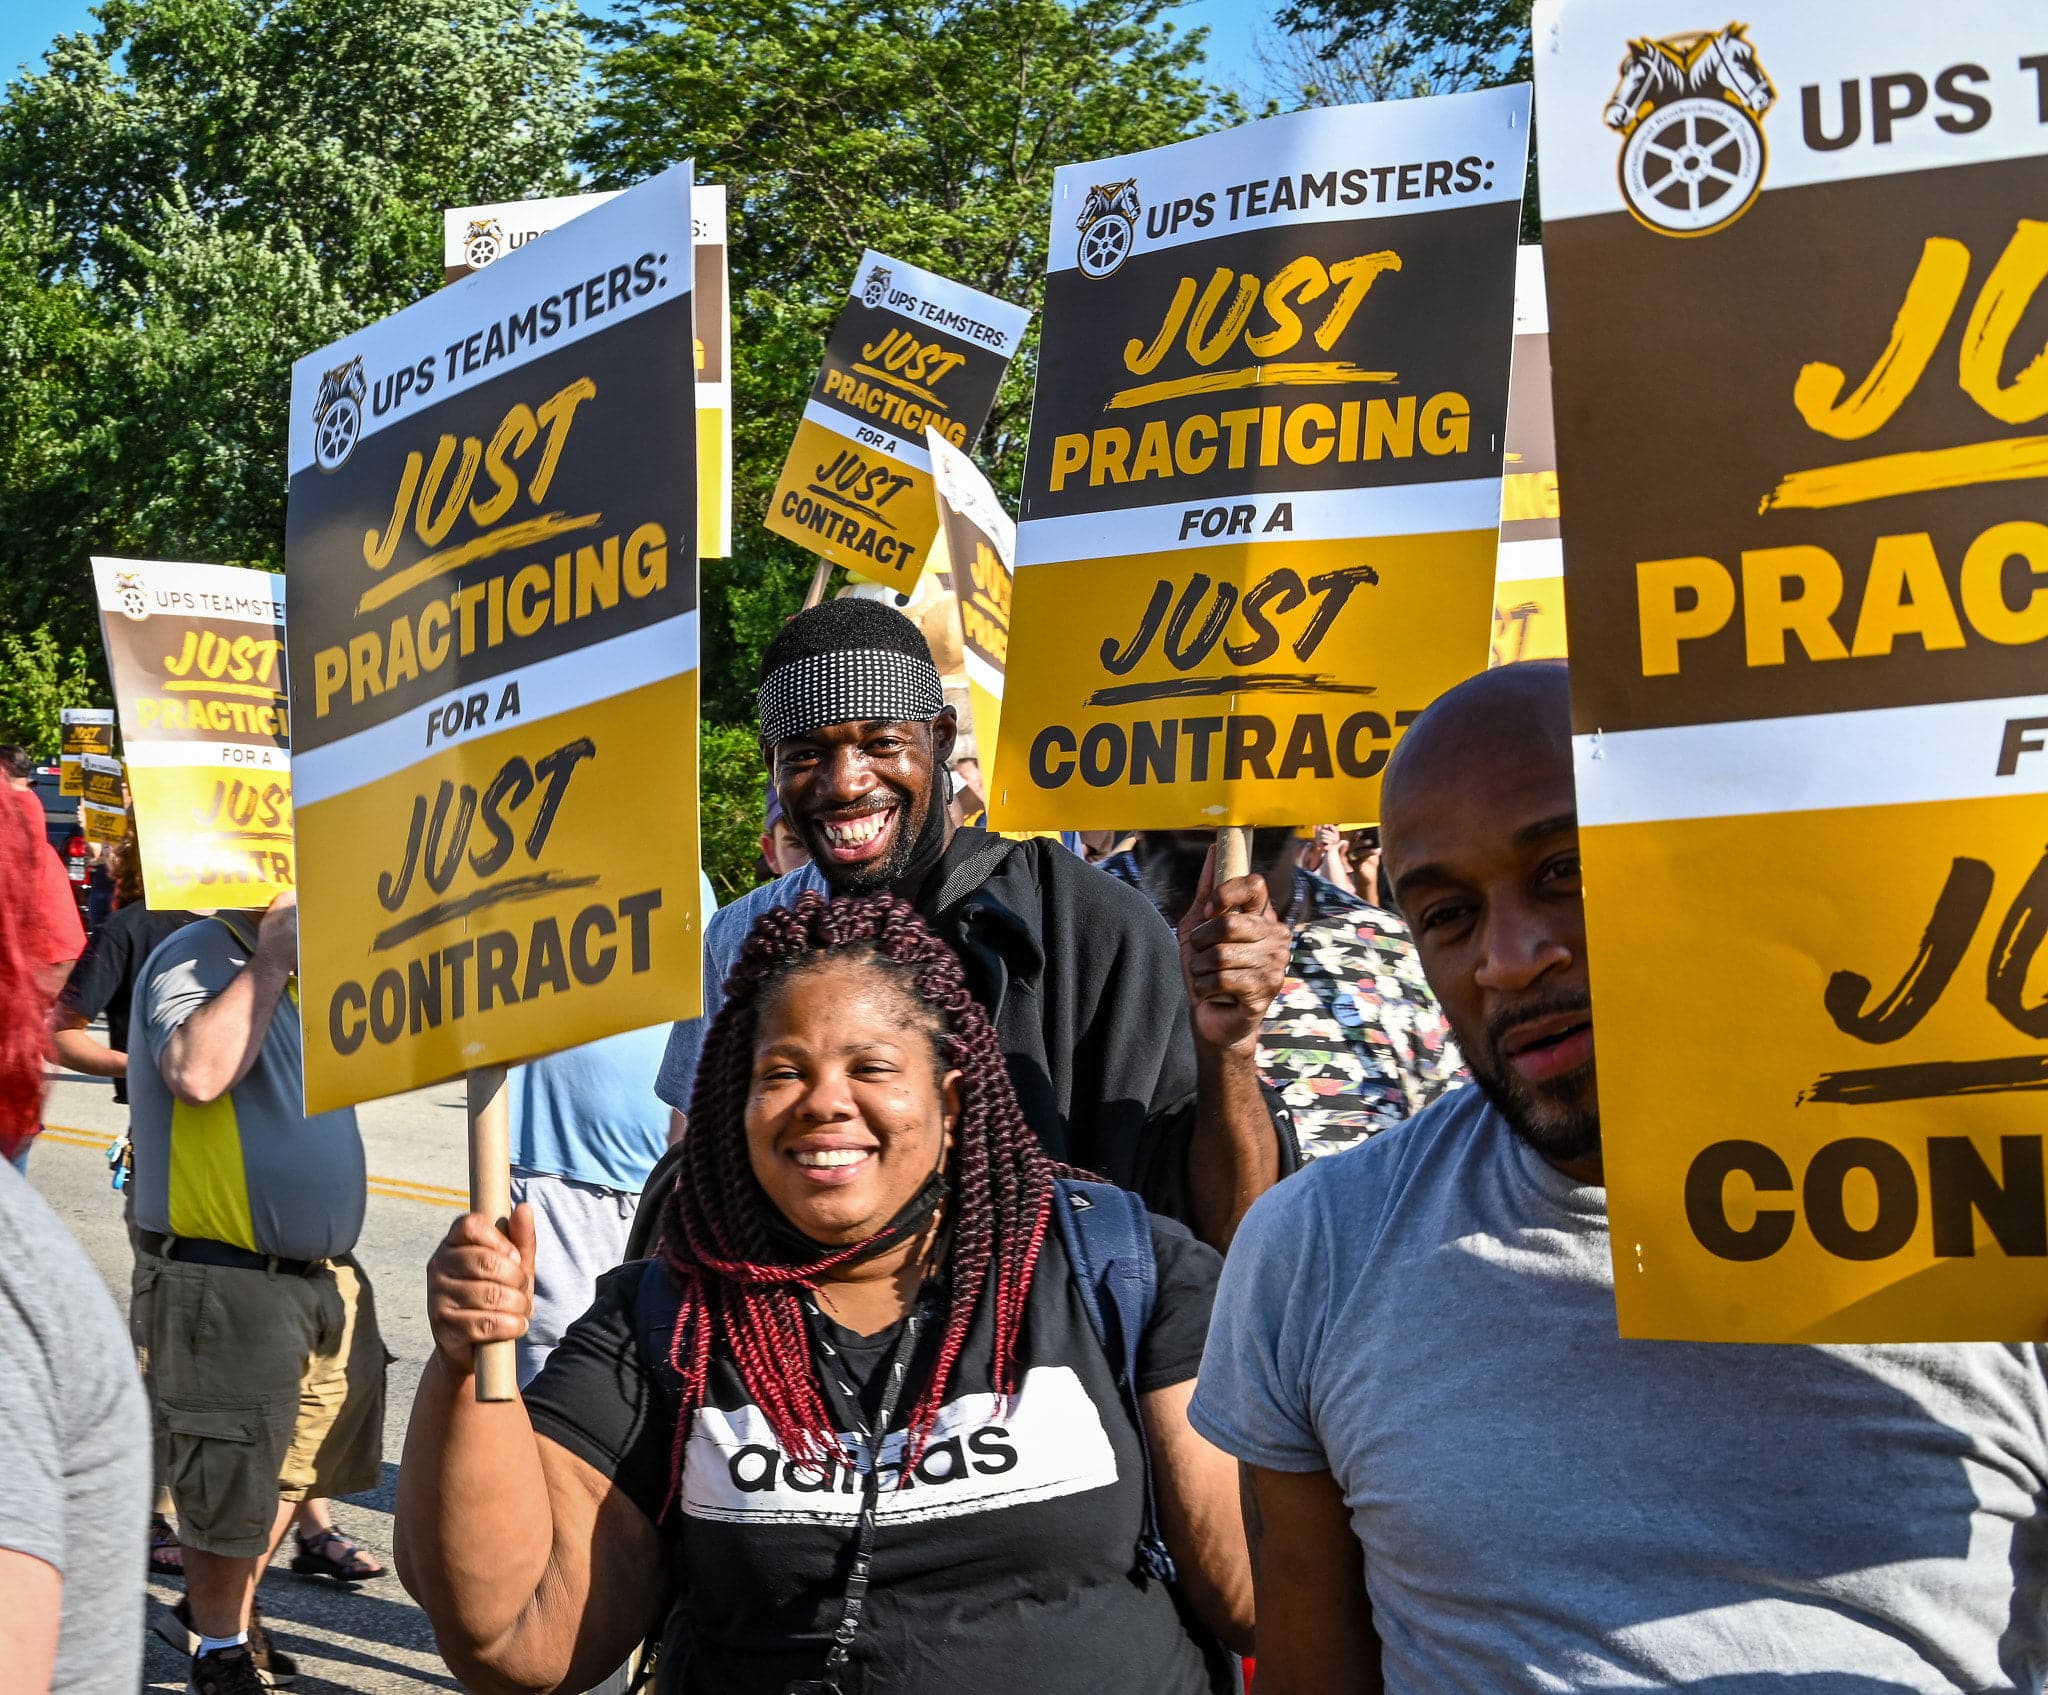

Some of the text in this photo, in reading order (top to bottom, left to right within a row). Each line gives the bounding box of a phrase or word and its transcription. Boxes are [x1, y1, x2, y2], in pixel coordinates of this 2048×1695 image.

[1801, 63, 1993, 152] UPS
[1146, 192, 1215, 240] UPS
[1226, 156, 1495, 221] TEAMSTERS:
[509, 229, 553, 250] UP
[372, 252, 668, 419] UPS TEAMSTERS:
[887, 288, 1009, 351] UPS TEAMSTERS:
[1122, 249, 1402, 375] JUST
[862, 327, 966, 386] JUST
[823, 368, 968, 448] PRACTICING
[856, 426, 897, 454] FOR A
[1049, 392, 1470, 492] PRACTICING
[363, 376, 597, 571] JUST
[816, 450, 914, 509] JUST
[781, 490, 916, 571] CONTRACT
[1179, 502, 1293, 540] FOR A
[155, 590, 285, 619] UPS TEAMSTE
[314, 521, 668, 718] PRACTICING
[1100, 564, 1380, 675] JUST
[1636, 520, 2048, 677] PRAC
[163, 629, 285, 684] JUST
[426, 680, 521, 748] FOR A
[223, 748, 272, 765] FOR A
[192, 779, 293, 829] JUS
[377, 736, 596, 912] JUST
[328, 887, 663, 1056] CONTRACT
